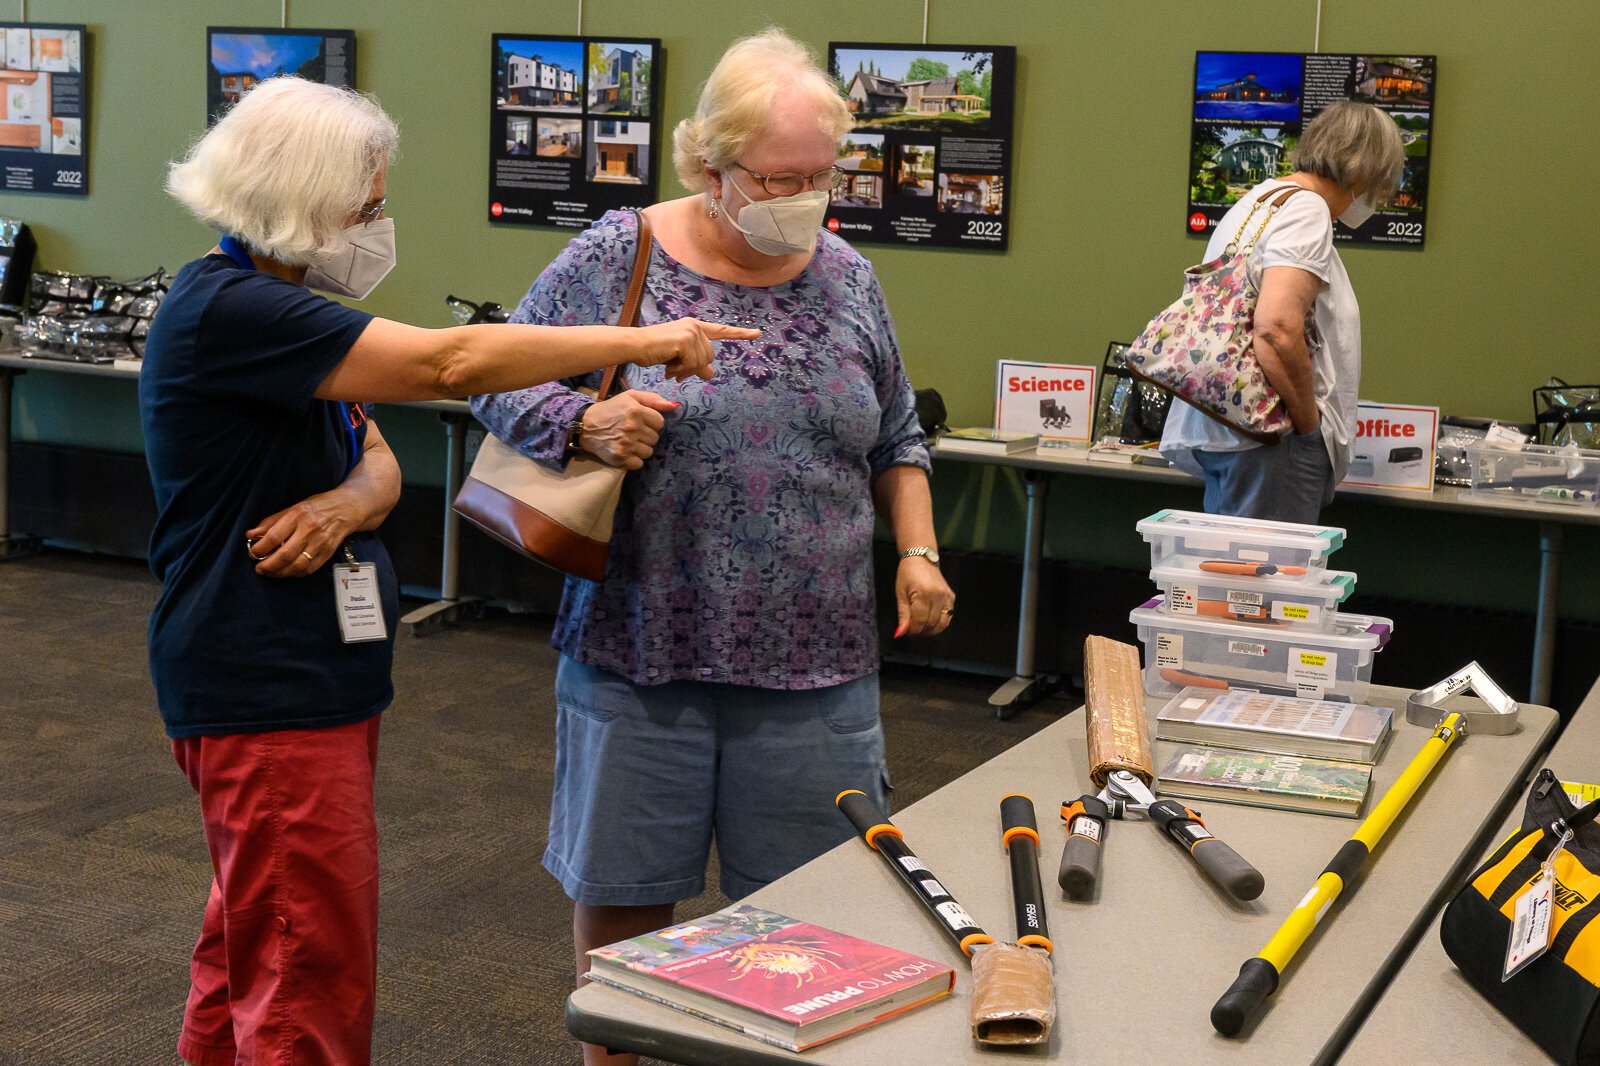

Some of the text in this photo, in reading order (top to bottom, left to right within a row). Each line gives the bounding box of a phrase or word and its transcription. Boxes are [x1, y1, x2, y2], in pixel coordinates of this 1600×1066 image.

[57, 170, 81, 184] 2022
[518, 208, 533, 216] Valley
[856, 223, 872, 231] Valley
[968, 220, 1002, 237] 2022
[1190, 218, 1206, 226] AIA
[1387, 222, 1422, 236] 2022
[1008, 376, 1085, 392] Science
[886, 961, 935, 986] HOW
[858, 973, 889, 992] TO
[783, 986, 864, 1016] PRUNE
